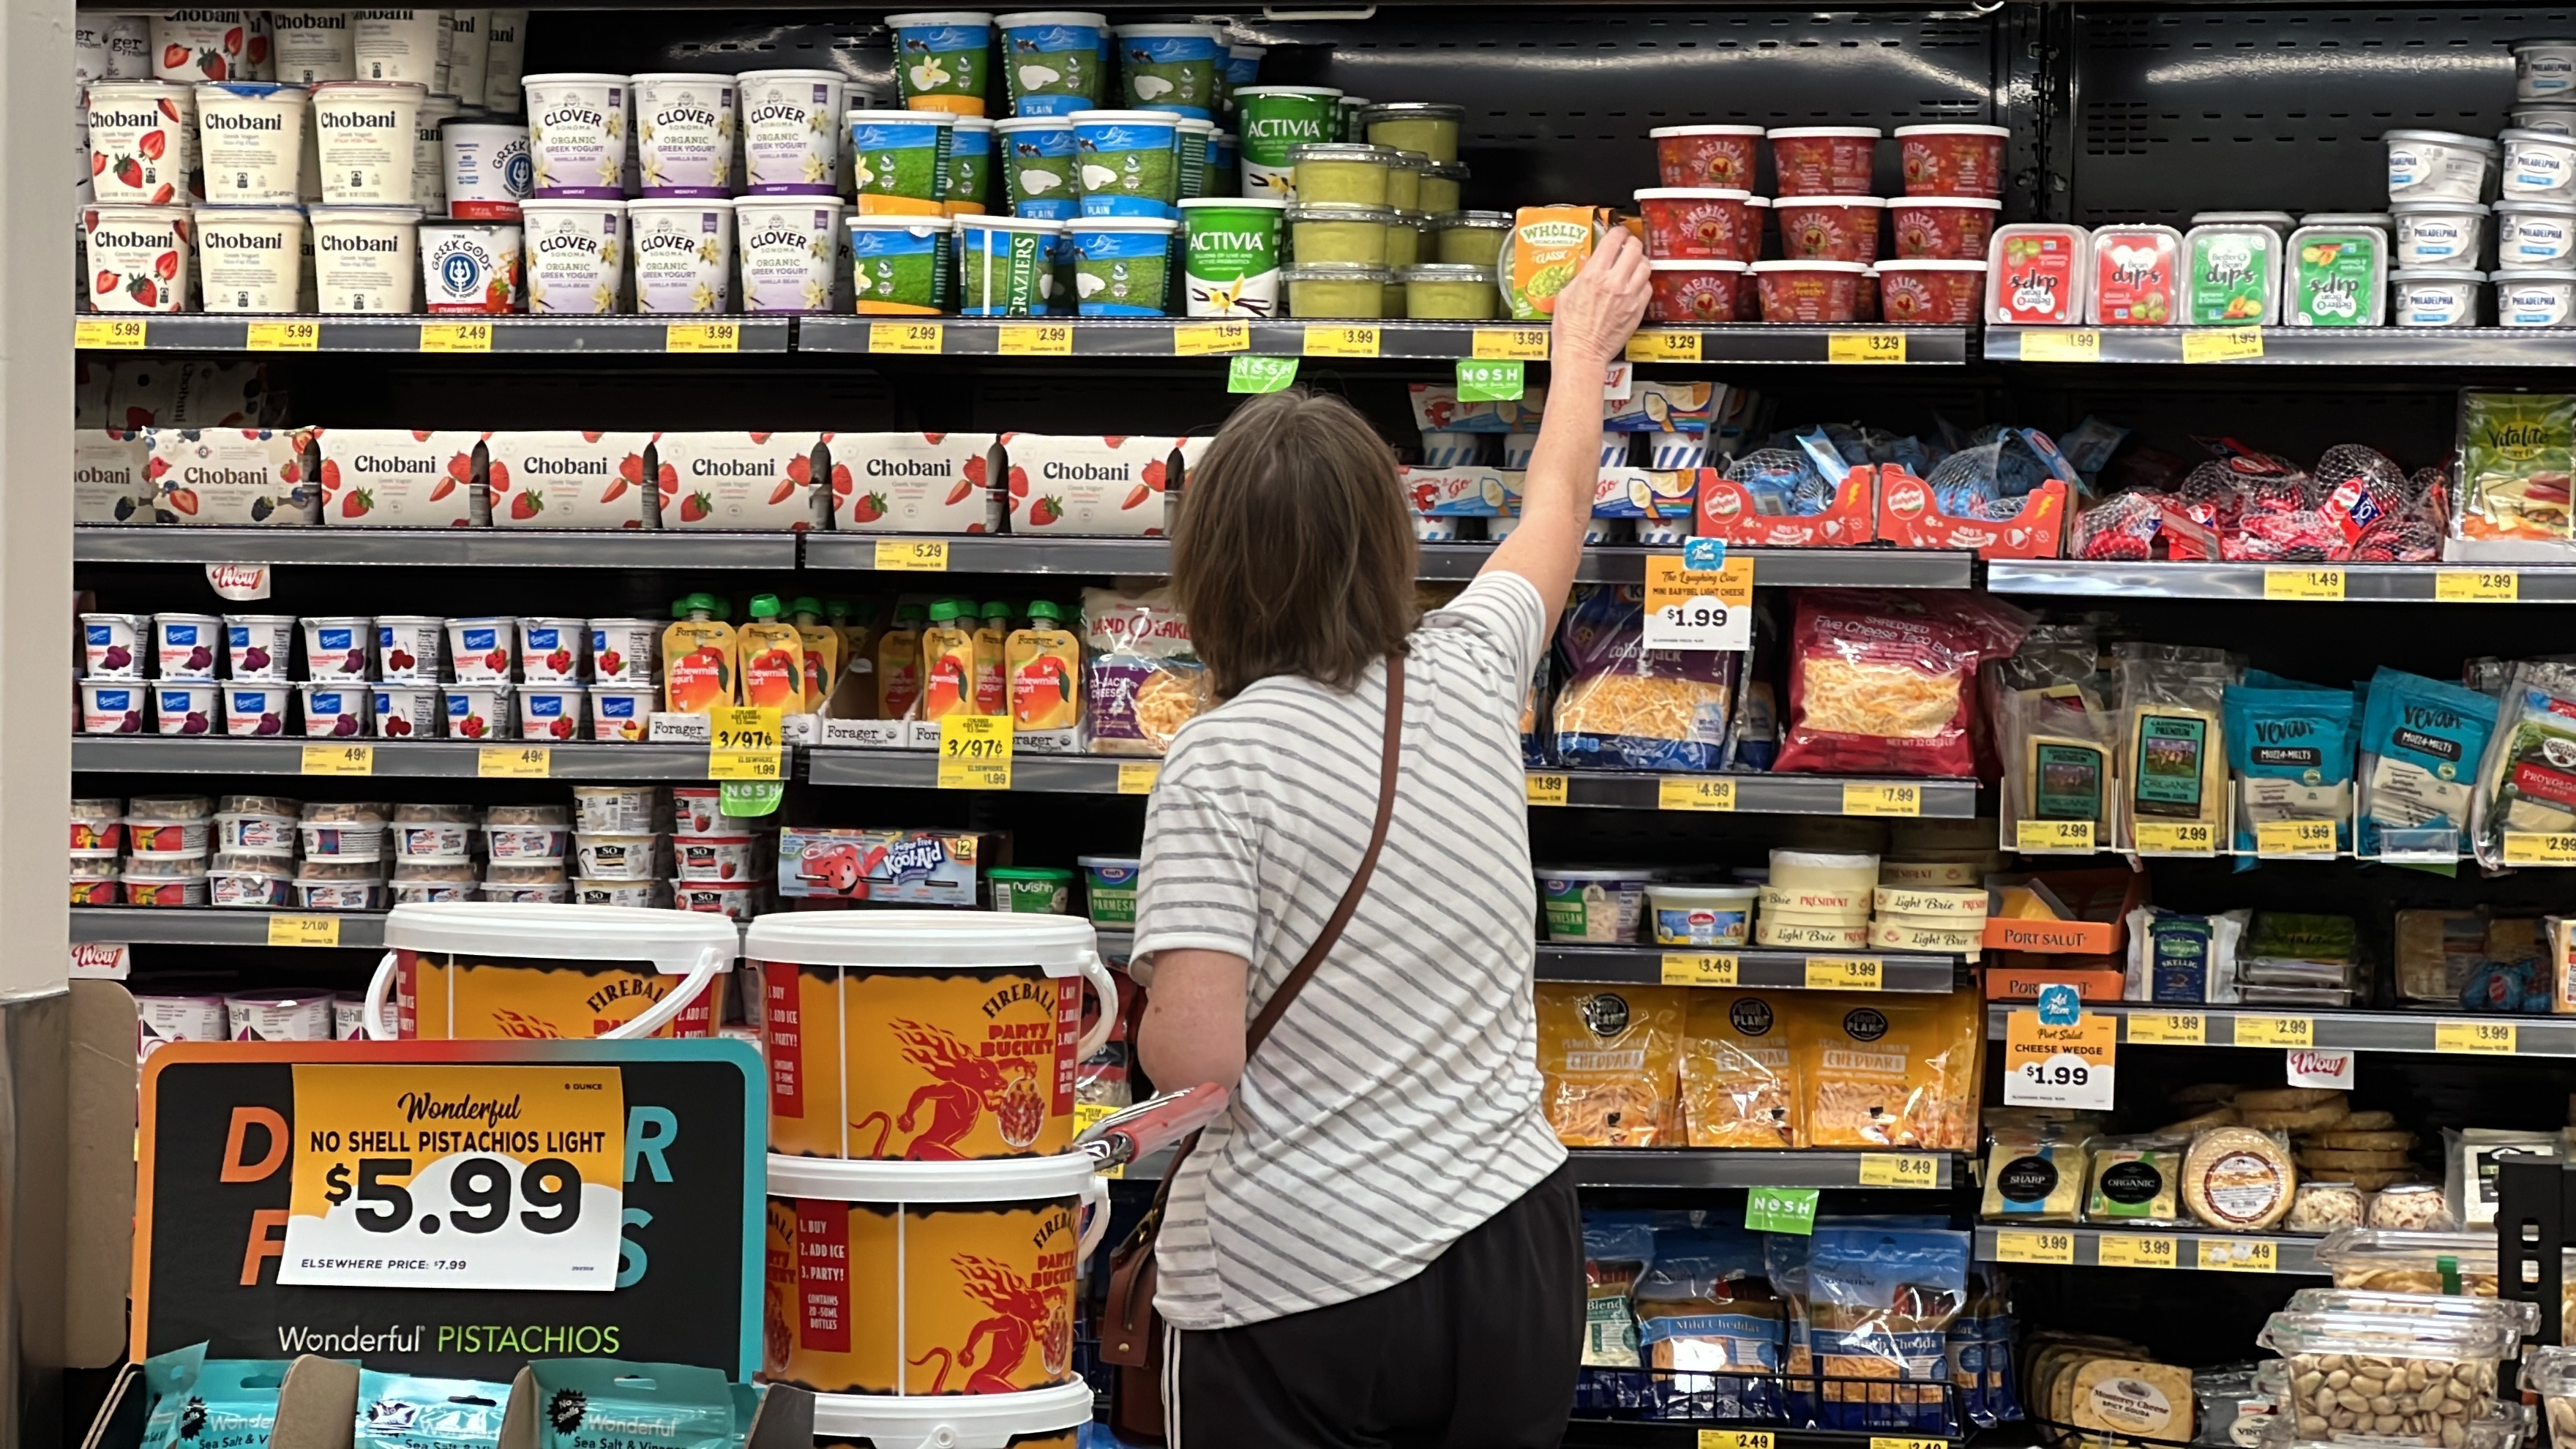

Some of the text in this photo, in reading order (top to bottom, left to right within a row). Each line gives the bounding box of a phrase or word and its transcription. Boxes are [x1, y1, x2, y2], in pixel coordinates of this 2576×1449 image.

[657, 108, 714, 127] CLOVER
[751, 105, 804, 124] CLOVER
[1026, 105, 1052, 114] PLAIN
[90, 110, 158, 128] Chobani
[205, 113, 282, 130] Chobani
[321, 111, 397, 128] Chobani
[544, 109, 602, 128] CLOVER
[1248, 121, 1319, 138] ACTIVIA
[550, 136, 596, 144] ORGANIC
[658, 144, 716, 152] GREEK YOGURT
[663, 136, 708, 144] ORGANIC
[2517, 157, 2560, 170] PHILADELPHIA
[1087, 206, 1109, 214] PLAIN
[95, 231, 173, 249] Chobani
[205, 233, 282, 250] Chobani
[750, 231, 806, 250] CLOVER
[1190, 231, 1263, 251] ACTIVIA
[1521, 225, 1588, 242] WHOLLY
[2415, 228, 2457, 239] PHILADELPHIA
[2519, 228, 2561, 239] PHILADELPHIA
[321, 235, 398, 252] Chobani
[539, 235, 596, 254] CLOVER
[640, 235, 694, 254] CLOVER
[1536, 250, 1567, 262] CLASSIC
[545, 263, 590, 271] ORGANIC
[1008, 234, 1035, 316] GRAZIERS
[2112, 264, 2160, 290] dips
[2206, 264, 2255, 290] dips
[2411, 296, 2453, 305] PHILADELPHIA
[2512, 296, 2556, 306] PHILADELPHIA
[1461, 367, 1519, 381] NOSH
[353, 455, 436, 473] Chobani
[523, 457, 607, 475] Chobani
[692, 459, 775, 476] Chobani
[866, 459, 952, 476] Chobani
[1042, 463, 1130, 482] Chobani
[1662, 572, 1738, 585] The Laughing Cow
[1721, 588, 1745, 596] CHEESE
[1667, 609, 1727, 626] $1.99
[1843, 618, 1897, 640] Cheese
[2404, 705, 2463, 728] vevan
[654, 723, 704, 735] Forager
[827, 726, 878, 738] Forager
[2255, 719, 2313, 744] vevan
[719, 732, 772, 748] 3/97¢
[948, 739, 1003, 756] 3/97¢
[344, 748, 366, 762] 49¢
[521, 750, 544, 763] 49¢
[956, 839, 970, 855] 12
[884, 842, 943, 876] Kool-Aid
[1013, 882, 1053, 894] nurishh
[698, 893, 713, 901] SO
[1800, 896, 1849, 908] PRÉSIDENT
[1895, 895, 1955, 911] Light Brie
[1912, 932, 1968, 947] Light Brie
[2004, 929, 2086, 947] PORT SALUT
[73, 944, 122, 968] Wow!
[981, 984, 1055, 1019] FIREBALL
[2053, 994, 2067, 1004] Ad
[989, 1023, 1050, 1040] PARTY
[2037, 1029, 2083, 1040] Port Salut
[981, 1039, 1053, 1057] BUCKET
[2015, 1044, 2103, 1055] CHEESE WEDGE
[2291, 1051, 2347, 1077] Wow!
[2027, 1066, 2089, 1086] $1.99
[574, 1082, 604, 1091] OUNCE
[397, 1092, 521, 1128] Wonderful
[310, 1131, 605, 1153] NO SHELL PISTACHIOS LIGHT
[2010, 1175, 2045, 1184] SHARP
[324, 1157, 583, 1235] $5.99
[1753, 1197, 1811, 1214] NOSH
[810, 1244, 827, 1257] ADD
[830, 1245, 845, 1259] ICE
[300, 1258, 467, 1270] ELSEWHERE PRICE: $7.99
[808, 1295, 839, 1306] CONTAINS
[1588, 1300, 1622, 1311] Blend
[810, 1319, 837, 1330] BOTTLES
[277, 1325, 621, 1354] Wonderful PISTACHIOS
[2137, 1400, 2169, 1415] Cheese
[588, 1415, 677, 1438] Wonderful
